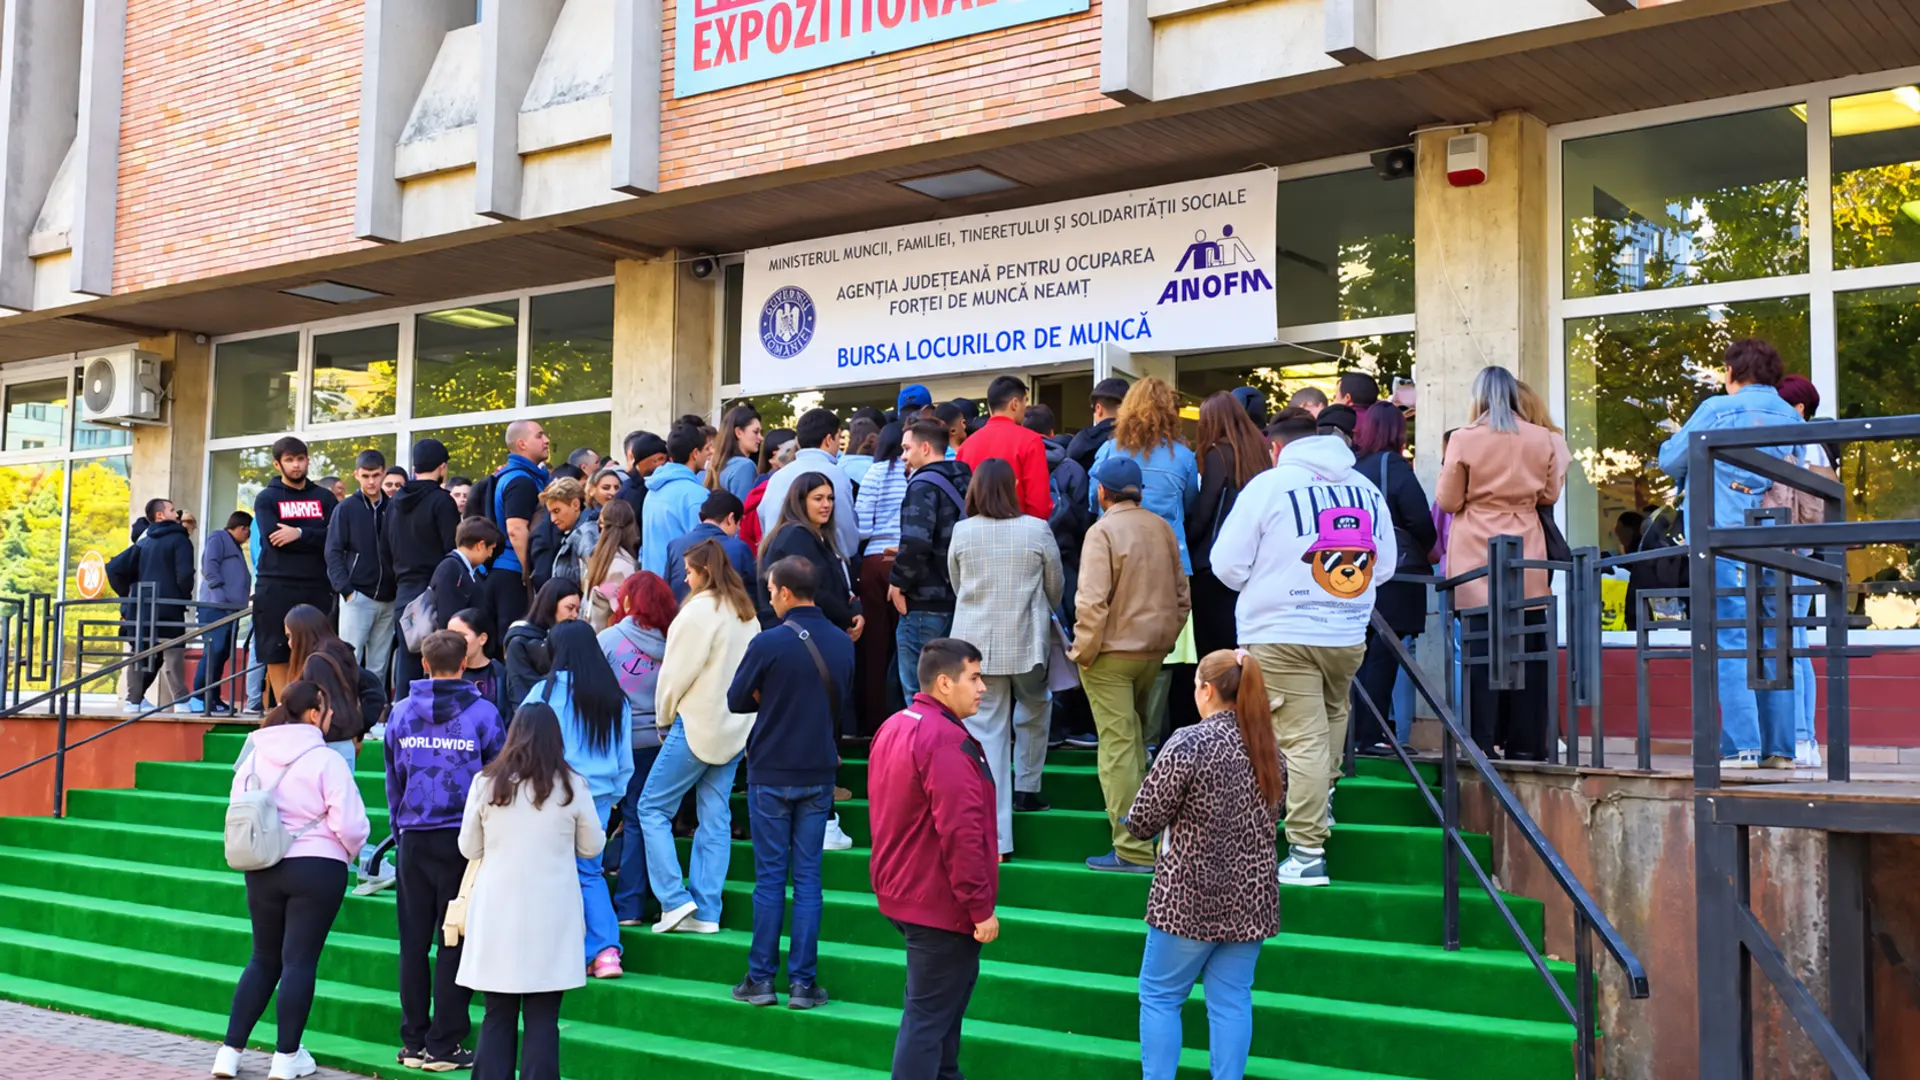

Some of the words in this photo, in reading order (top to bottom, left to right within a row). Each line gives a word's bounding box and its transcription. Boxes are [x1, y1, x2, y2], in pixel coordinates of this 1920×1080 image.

[693, 0, 998, 71] EXPOZITIO
[768, 253, 839, 271] MINISTERUL
[843, 241, 892, 260] MUNCII,
[897, 232, 956, 252] FAMILIEI,
[960, 218, 1049, 243] TINERETULUI
[1054, 215, 1066, 233] ȘI
[1071, 197, 1176, 227] SOLIDARITĂȚII
[1182, 189, 1247, 212] SOCIALE
[836, 279, 898, 301] AGENȚIA
[902, 264, 991, 292] JUDEȚEANĂ
[997, 259, 1060, 280] PENTRU
[1066, 247, 1155, 272] OCUPAREA
[1157, 268, 1273, 305] ANOFM
[890, 296, 943, 316] FORȚEI
[948, 292, 967, 308] DE
[972, 284, 1029, 307] MUNCĂ
[1034, 279, 1091, 300] NEAMȚ
[837, 343, 900, 368] BURSA
[906, 330, 1026, 361] LOCURILOR
[1034, 326, 1062, 349] DE
[1069, 311, 1152, 346] MUNCĂ
[280, 501, 322, 518] MARVEL
[398, 736, 475, 751] WORLDWIDE
